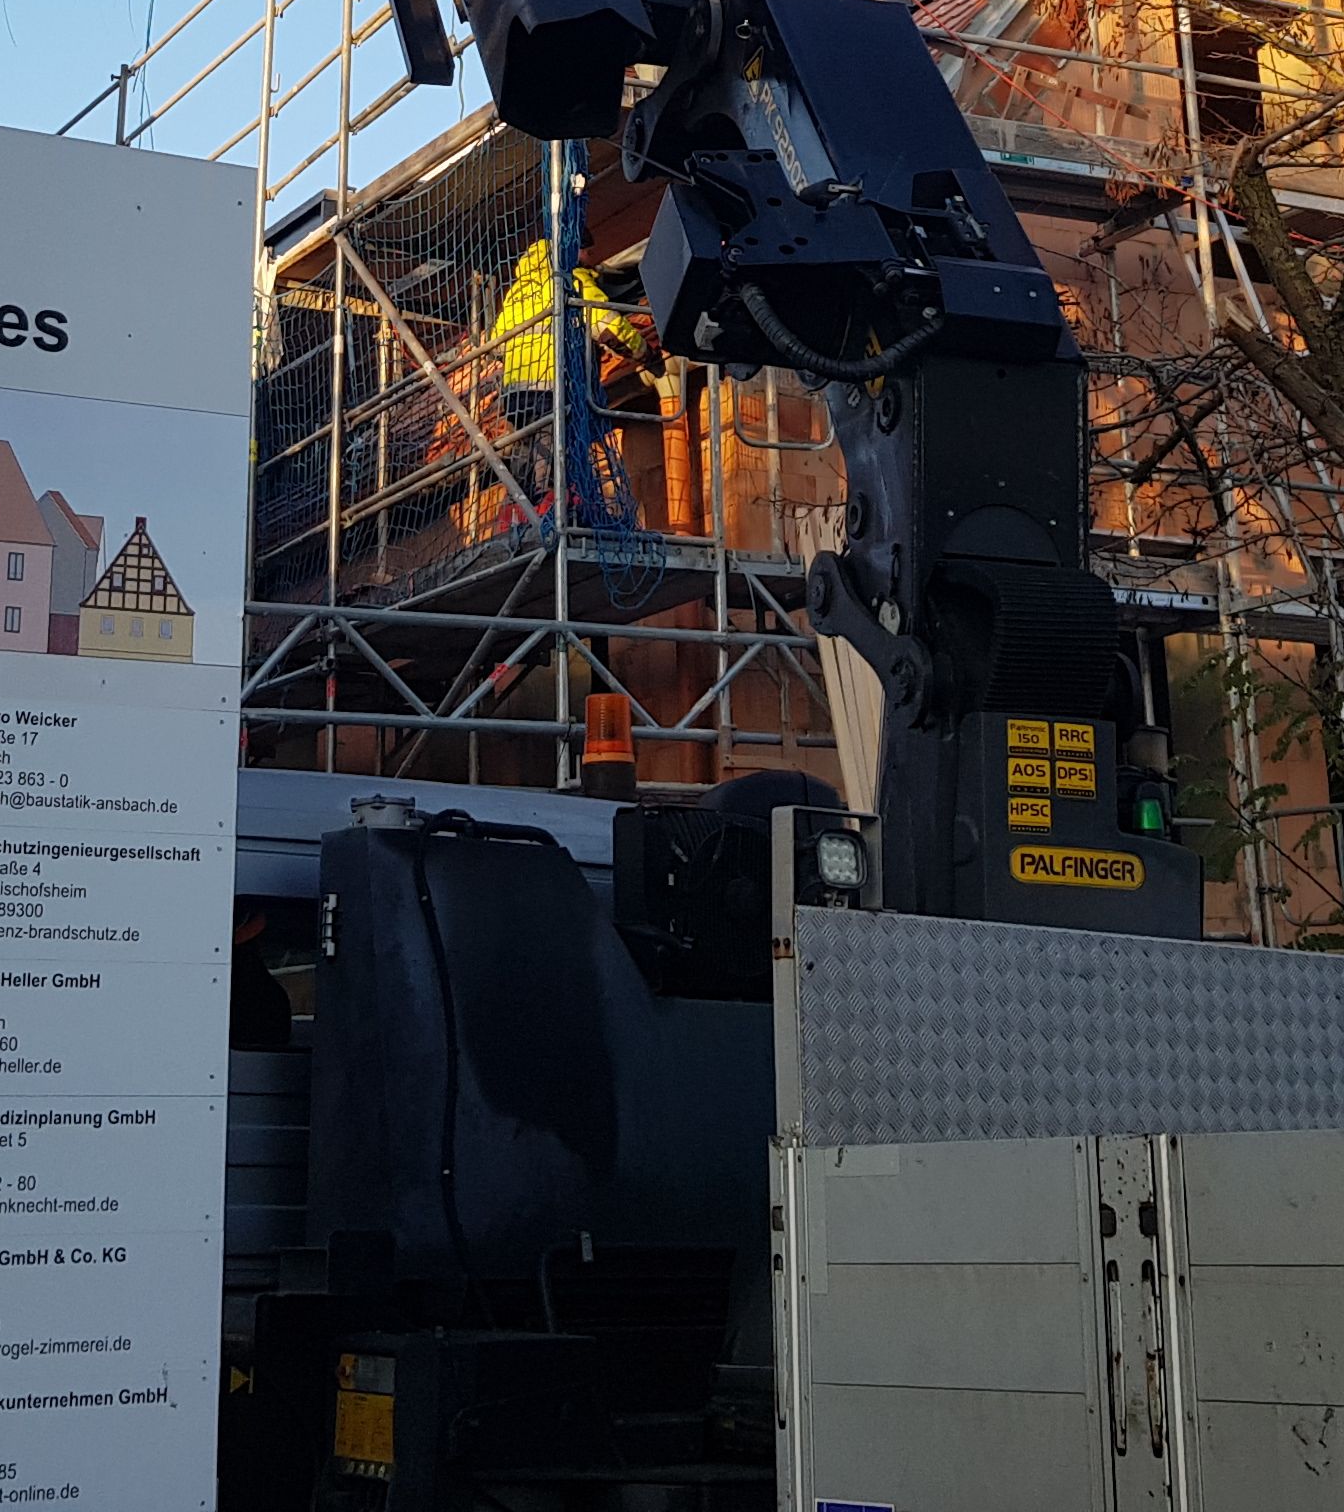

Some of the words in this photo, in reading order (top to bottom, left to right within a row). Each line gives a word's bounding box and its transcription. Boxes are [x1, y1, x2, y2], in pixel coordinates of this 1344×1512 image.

[22, 732, 38, 746] 17
[1018, 733, 1040, 744] 150
[1059, 728, 1090, 744] RRC
[1011, 763, 1046, 778] AOS
[1057, 766, 1089, 781] DPS
[18, 772, 44, 787] 863
[1010, 802, 1049, 817] HPSC
[1020, 853, 1136, 882] PALFINGER
[1, 972, 47, 987] Heller
[52, 973, 100, 988] GmbH
[108, 1110, 155, 1125] GmbH
[54, 1249, 65, 1264] &
[71, 1248, 96, 1264] Co.
[103, 1247, 126, 1263] KG
[119, 1384, 168, 1404] GmbH
